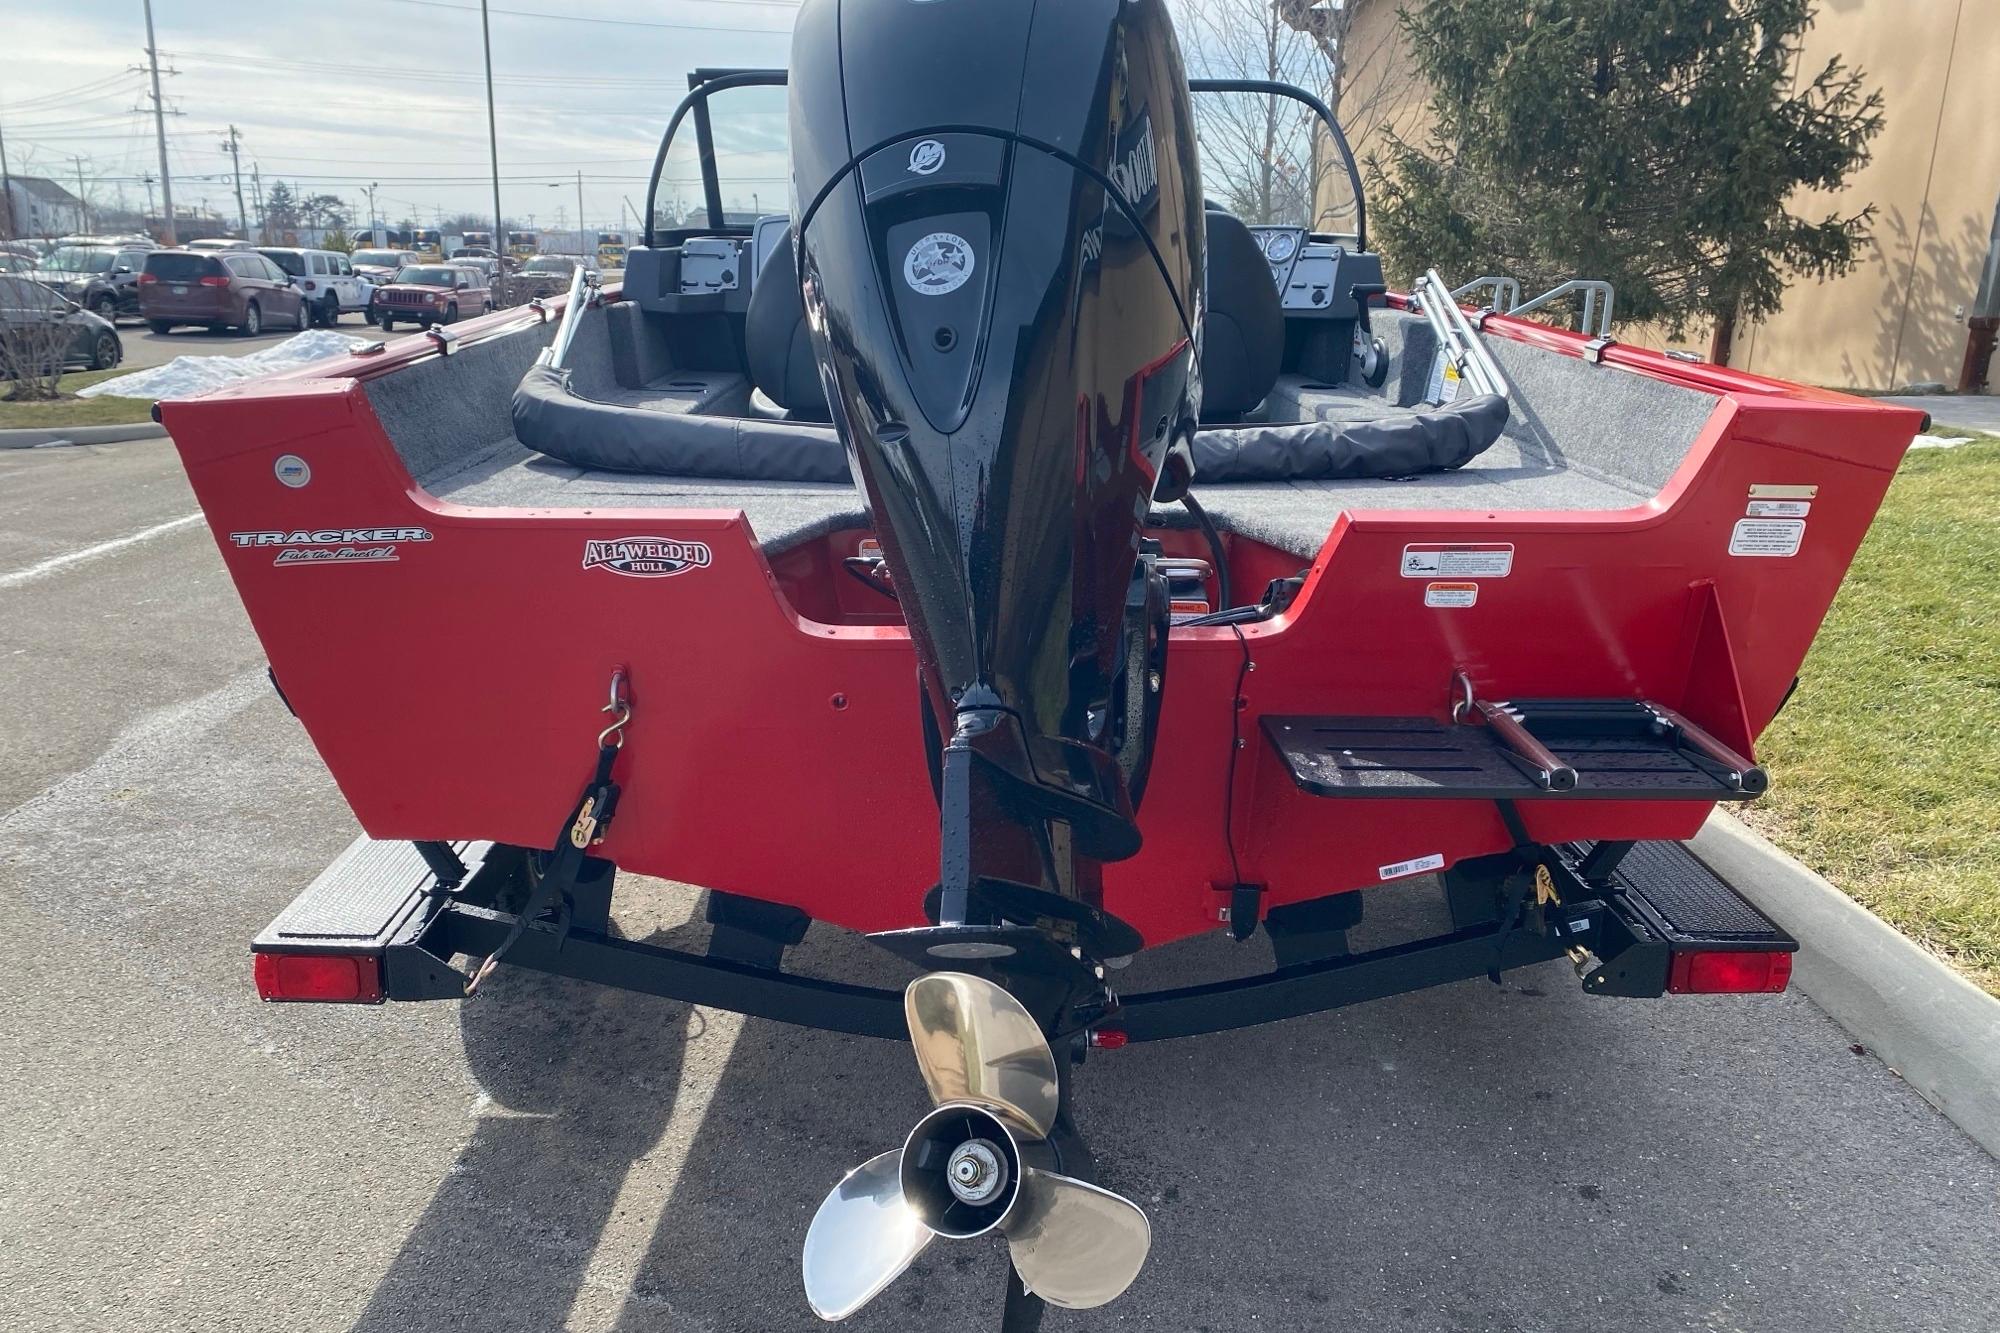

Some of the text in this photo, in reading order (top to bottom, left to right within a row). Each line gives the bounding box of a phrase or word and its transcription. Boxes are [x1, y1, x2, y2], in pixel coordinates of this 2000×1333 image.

[945, 234, 967, 247] LOW
[231, 527, 424, 546] TRACKER
[278, 549, 310, 560] Fish
[311, 549, 333, 559] the
[586, 542, 708, 564] ALL WELDED
[630, 562, 667, 572] HULL
